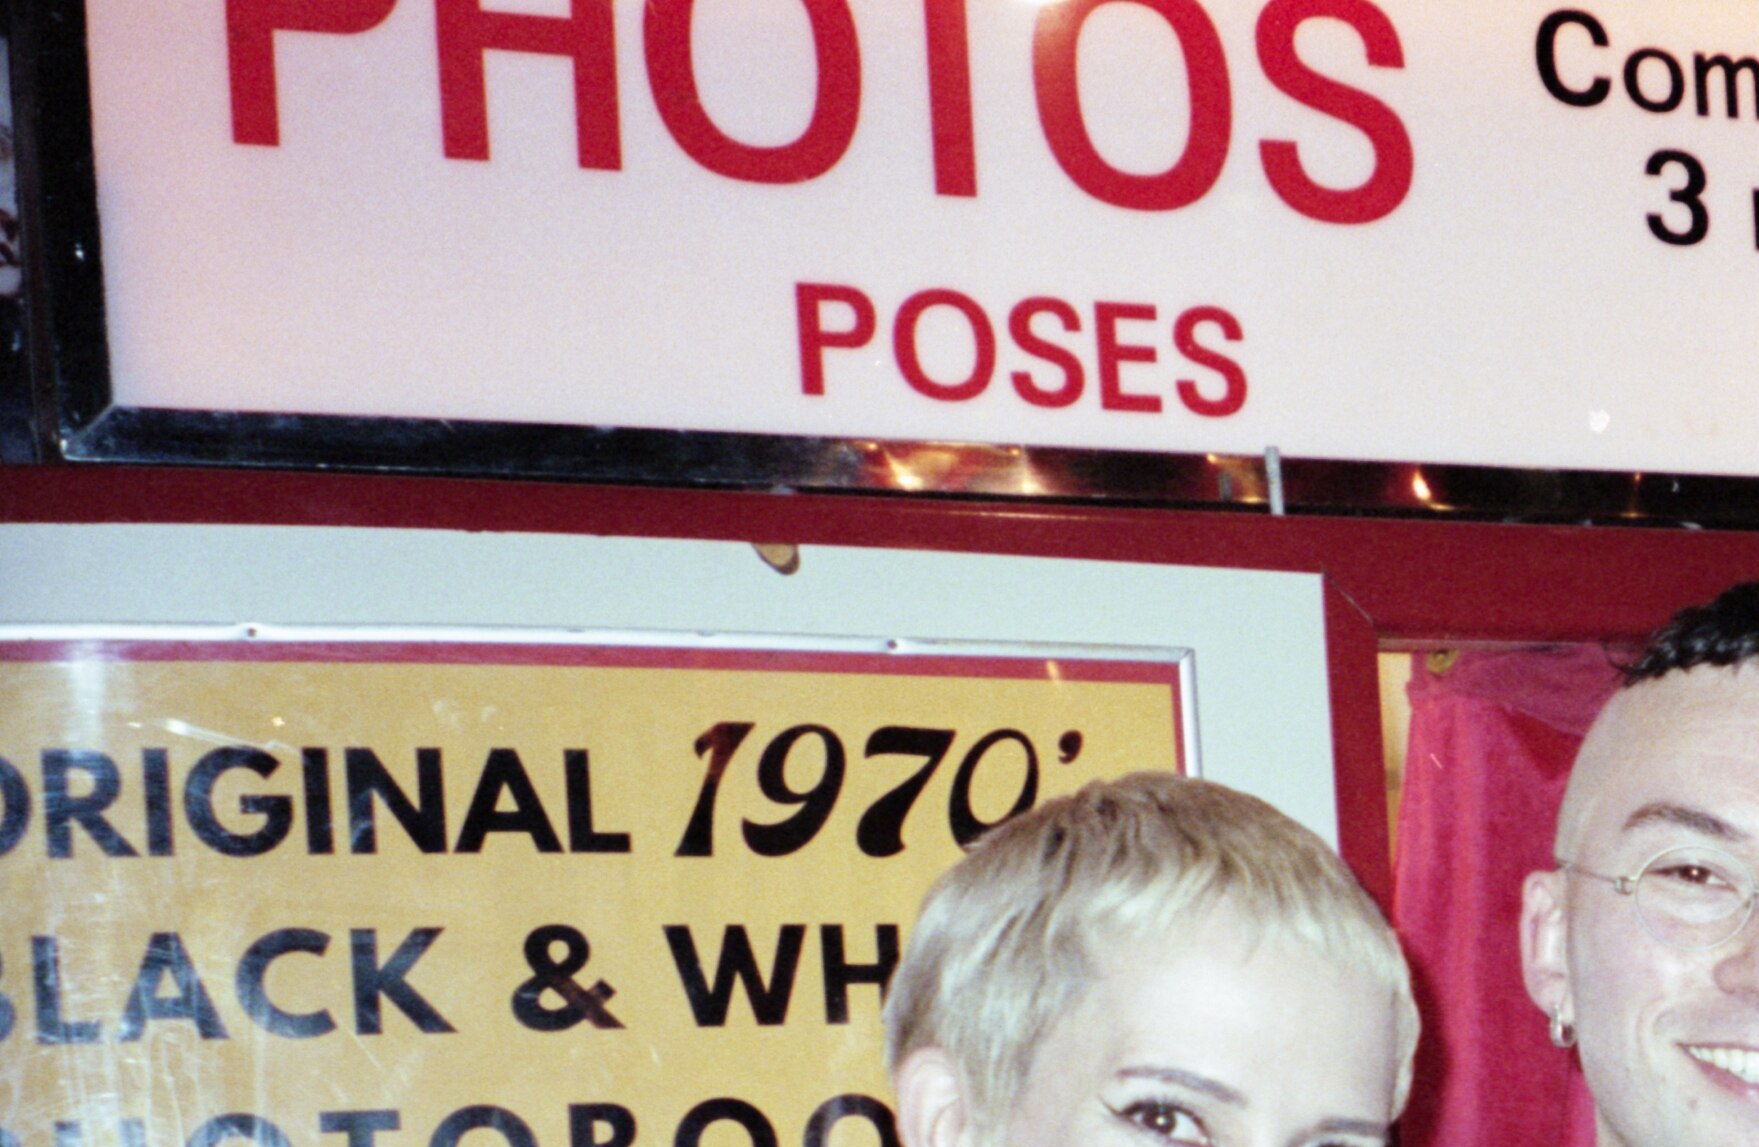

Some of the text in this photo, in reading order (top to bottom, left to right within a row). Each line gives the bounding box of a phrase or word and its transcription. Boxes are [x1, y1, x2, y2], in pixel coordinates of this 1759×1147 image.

[1645, 149, 1709, 246] 3
[795, 282, 1248, 417] POSES
[0, 745, 631, 857] RIGINAL
[0, 925, 457, 1044] LACK
[510, 924, 626, 1030] &
